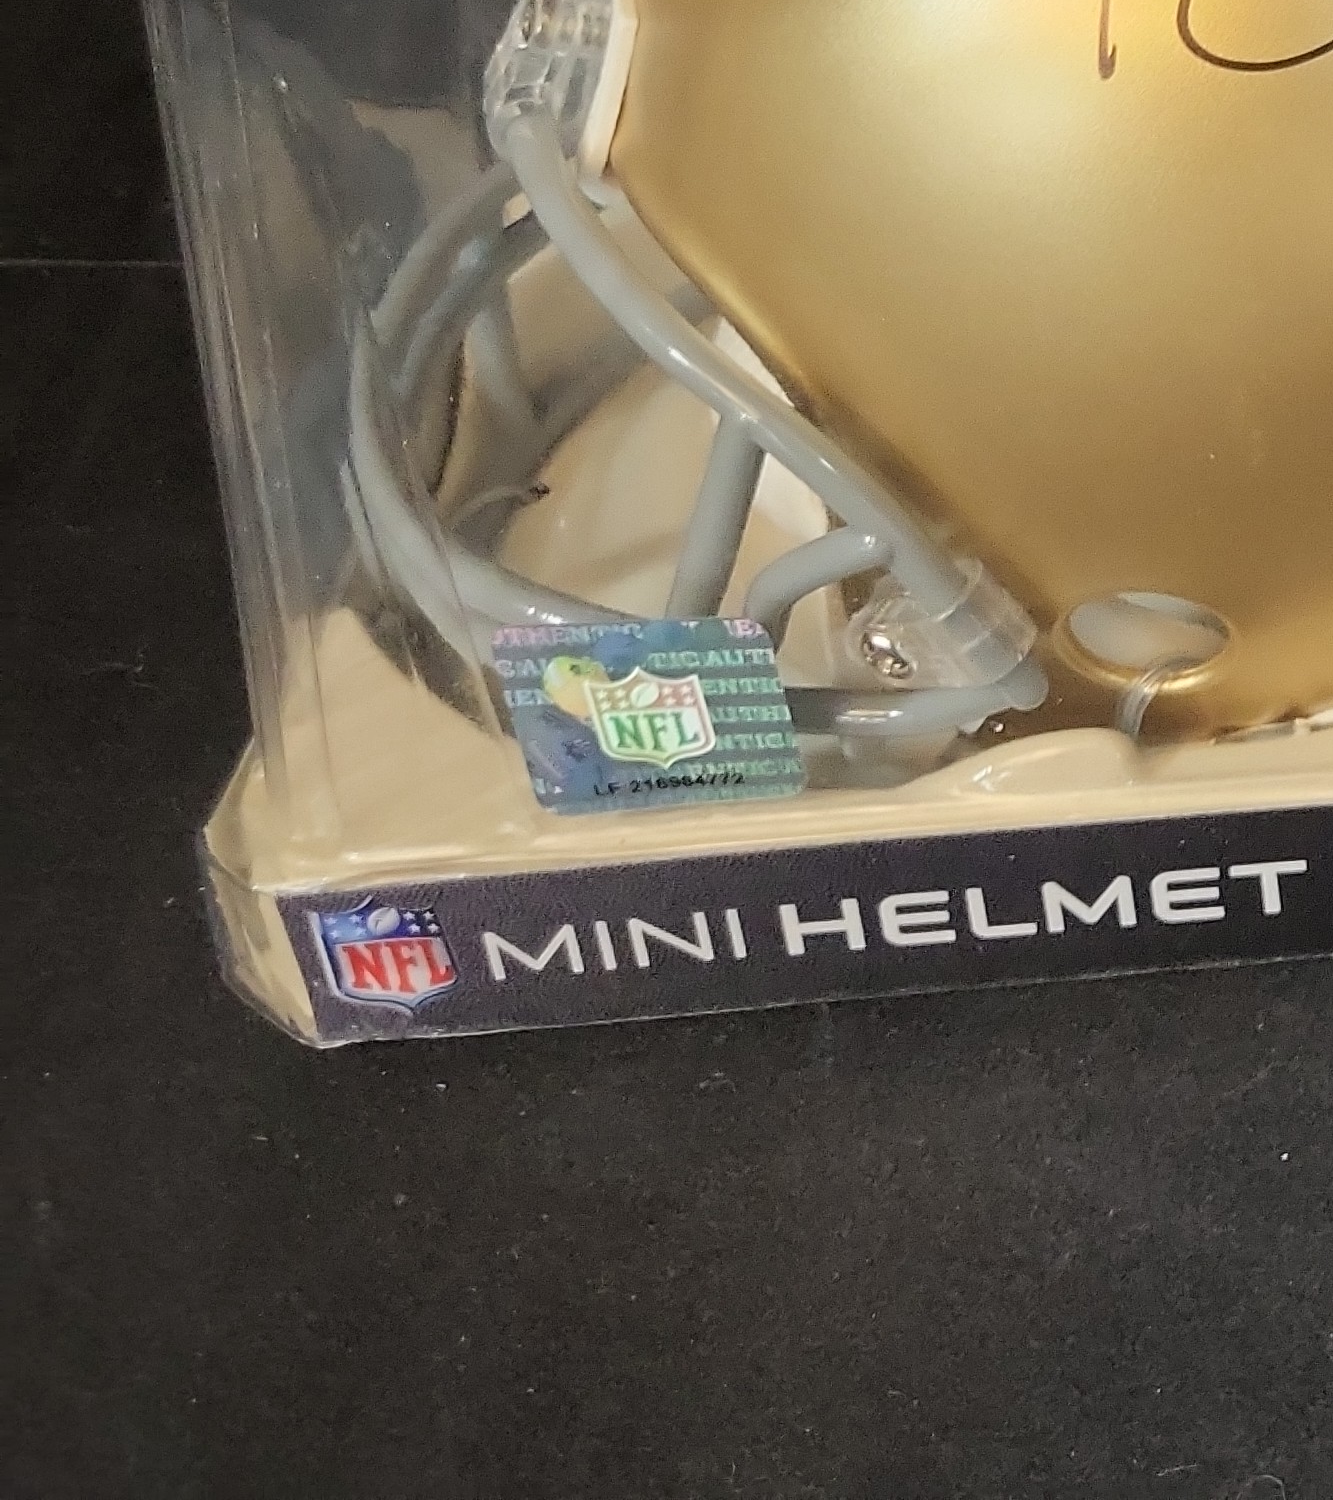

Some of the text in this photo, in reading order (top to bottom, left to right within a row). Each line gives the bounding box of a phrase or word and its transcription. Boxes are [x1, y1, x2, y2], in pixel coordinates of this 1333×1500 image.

[608, 712, 699, 750] NFL
[484, 859, 1308, 981] MINI HELMET
[342, 938, 455, 993] NFL
